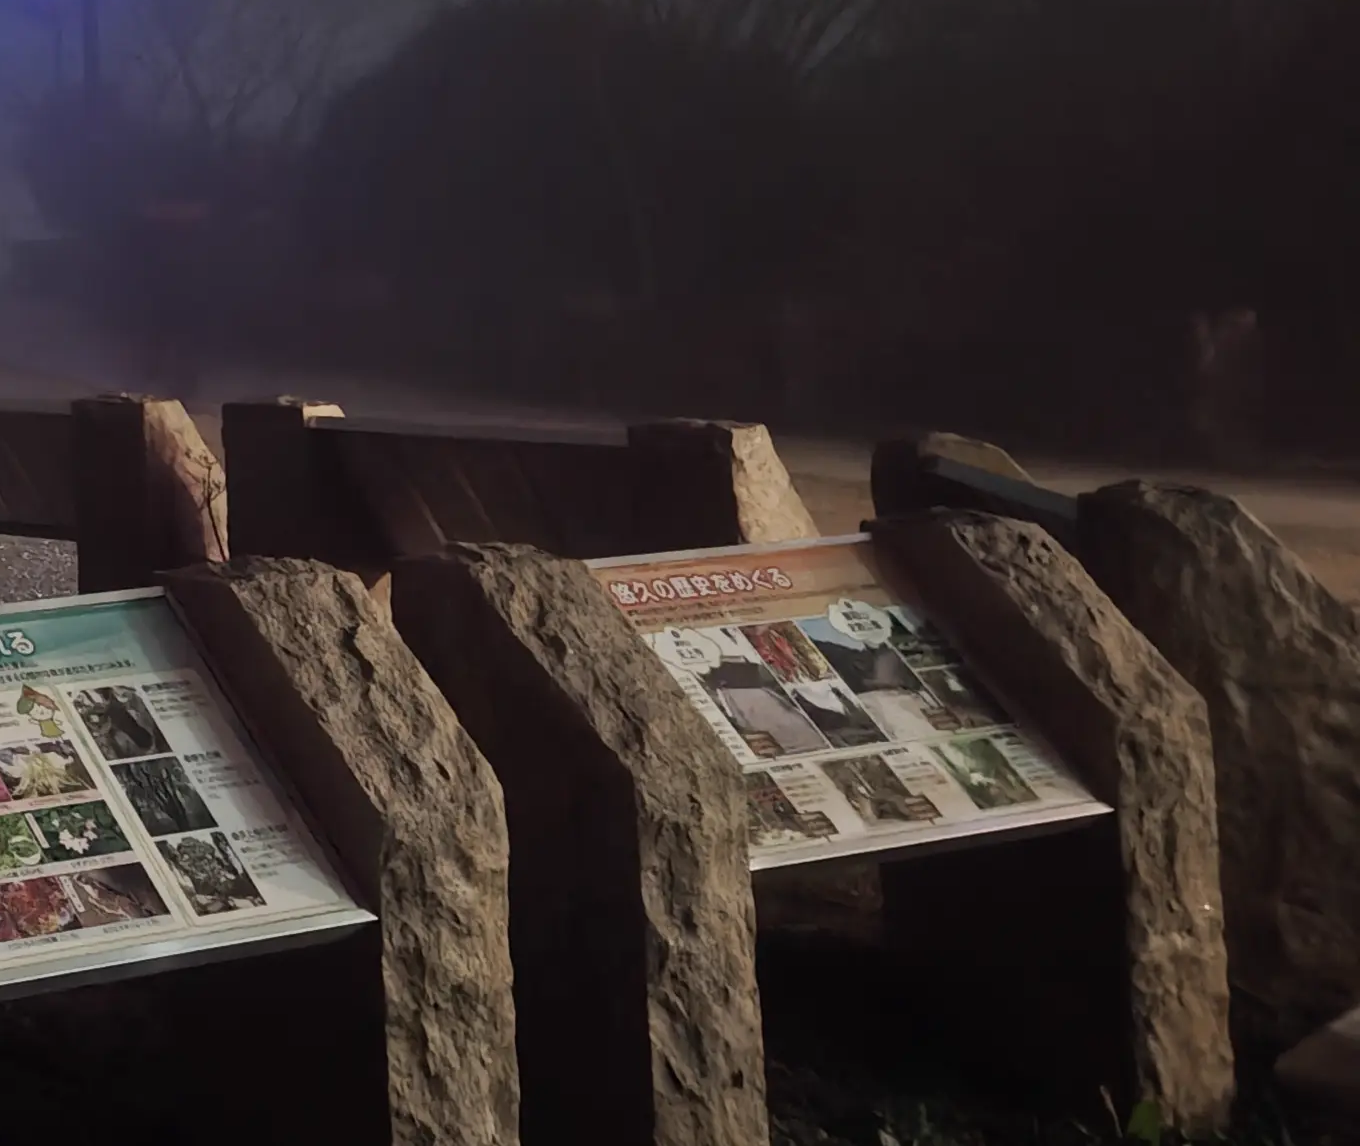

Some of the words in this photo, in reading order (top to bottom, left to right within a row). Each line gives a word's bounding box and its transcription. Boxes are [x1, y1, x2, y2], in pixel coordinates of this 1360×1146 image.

[609, 566, 794, 605] 悠久の歴史をめぐる
